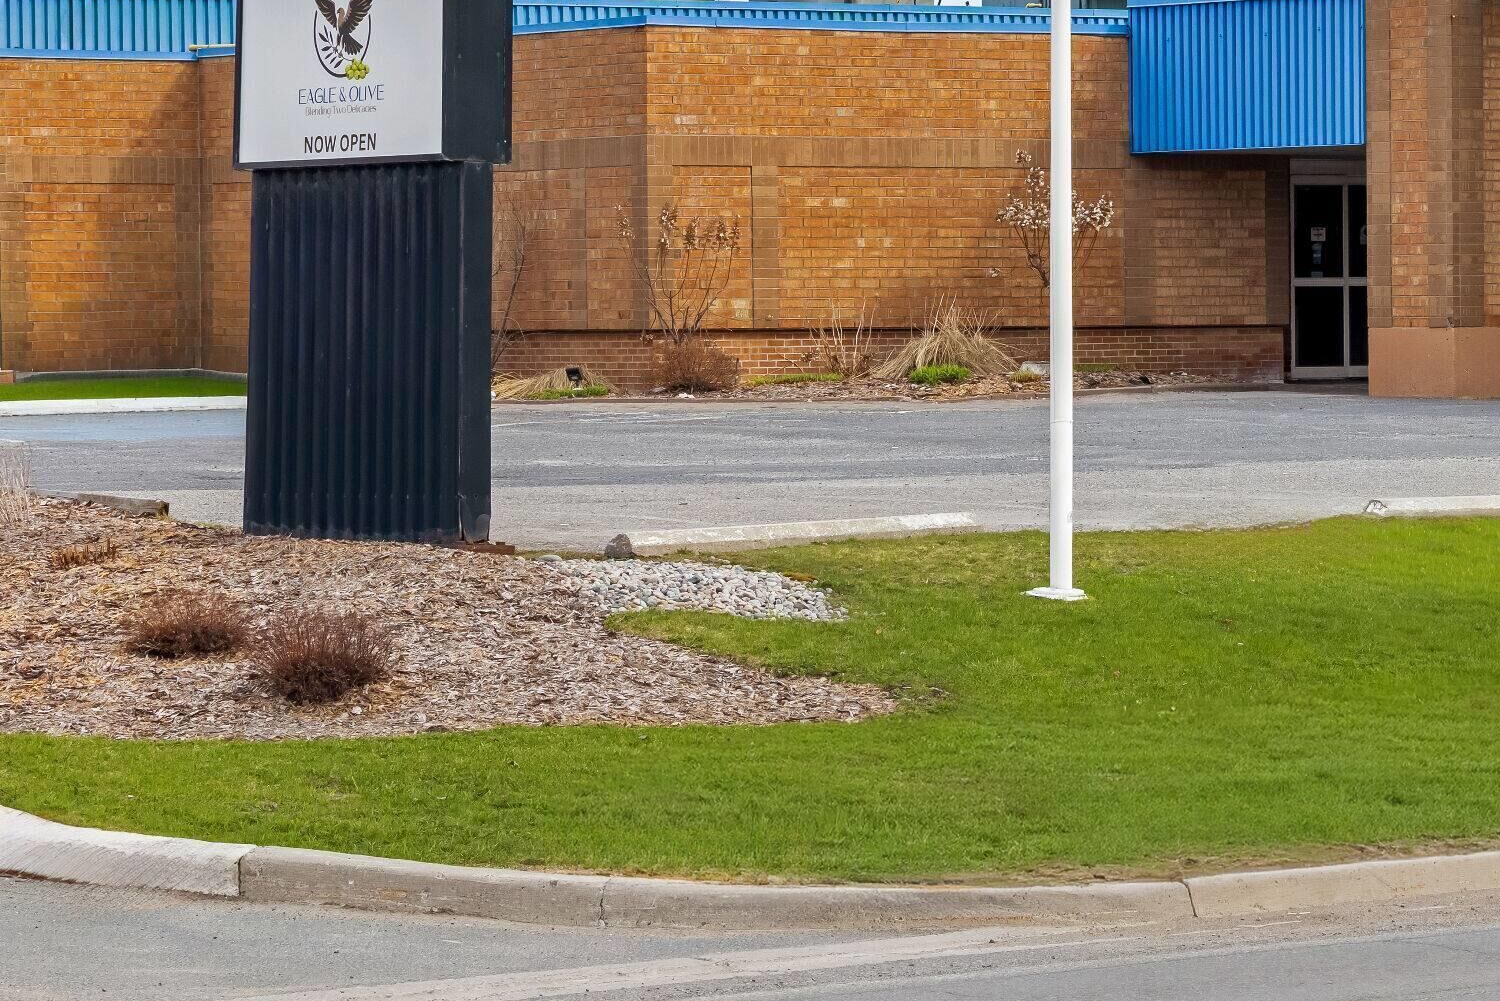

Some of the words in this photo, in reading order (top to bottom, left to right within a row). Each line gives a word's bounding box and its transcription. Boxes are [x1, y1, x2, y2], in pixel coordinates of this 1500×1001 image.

[298, 87, 337, 105] EAGLE
[339, 86, 347, 102] &
[349, 84, 385, 102] OLIVE
[304, 135, 337, 154] NOW
[340, 133, 377, 152] OPEN
